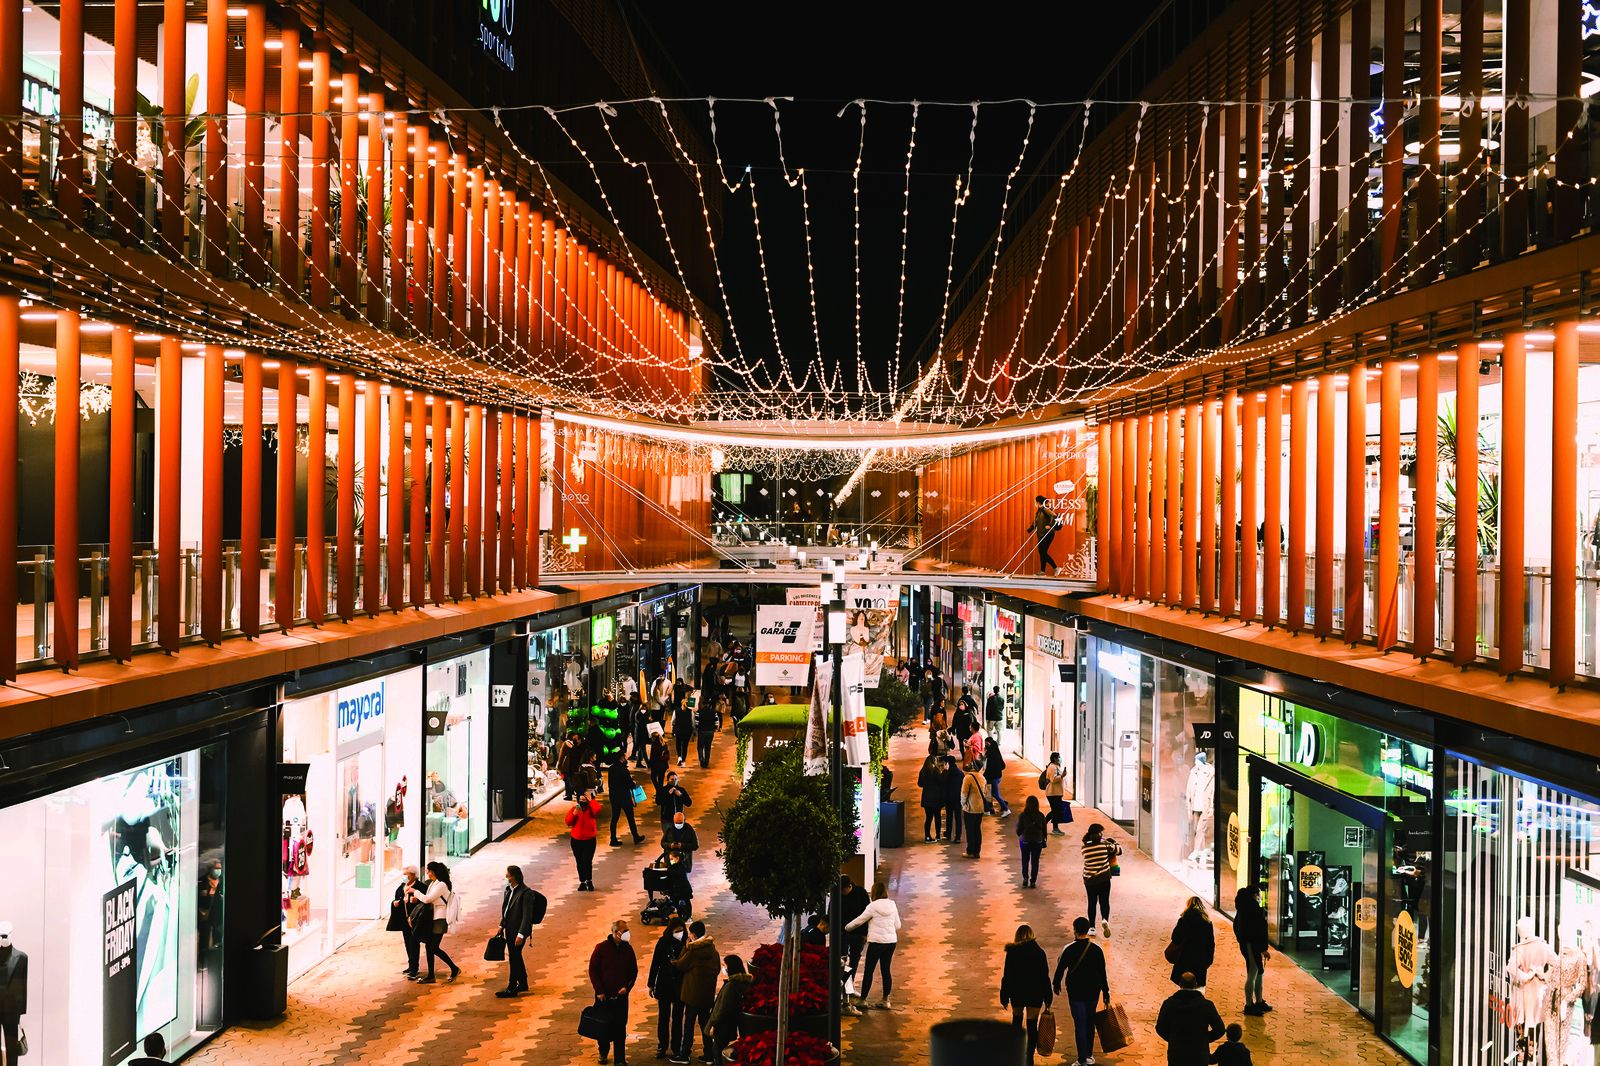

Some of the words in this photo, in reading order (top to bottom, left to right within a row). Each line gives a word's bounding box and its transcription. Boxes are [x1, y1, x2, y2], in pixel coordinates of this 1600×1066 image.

[480, 23, 514, 71] sportclub
[1042, 498, 1081, 510] GUESS
[760, 627, 798, 635] GARAGE
[769, 654, 804, 662] PARKING
[337, 681, 385, 732] mayoral
[1200, 730, 1212, 739] JD
[1296, 720, 1321, 768] JD
[105, 886, 135, 933] BLACK
[104, 917, 135, 966] FRIDAY
[1398, 923, 1413, 944] BLACK
[1398, 934, 1413, 954] FRIDAY
[1399, 946, 1413, 969] 50%
